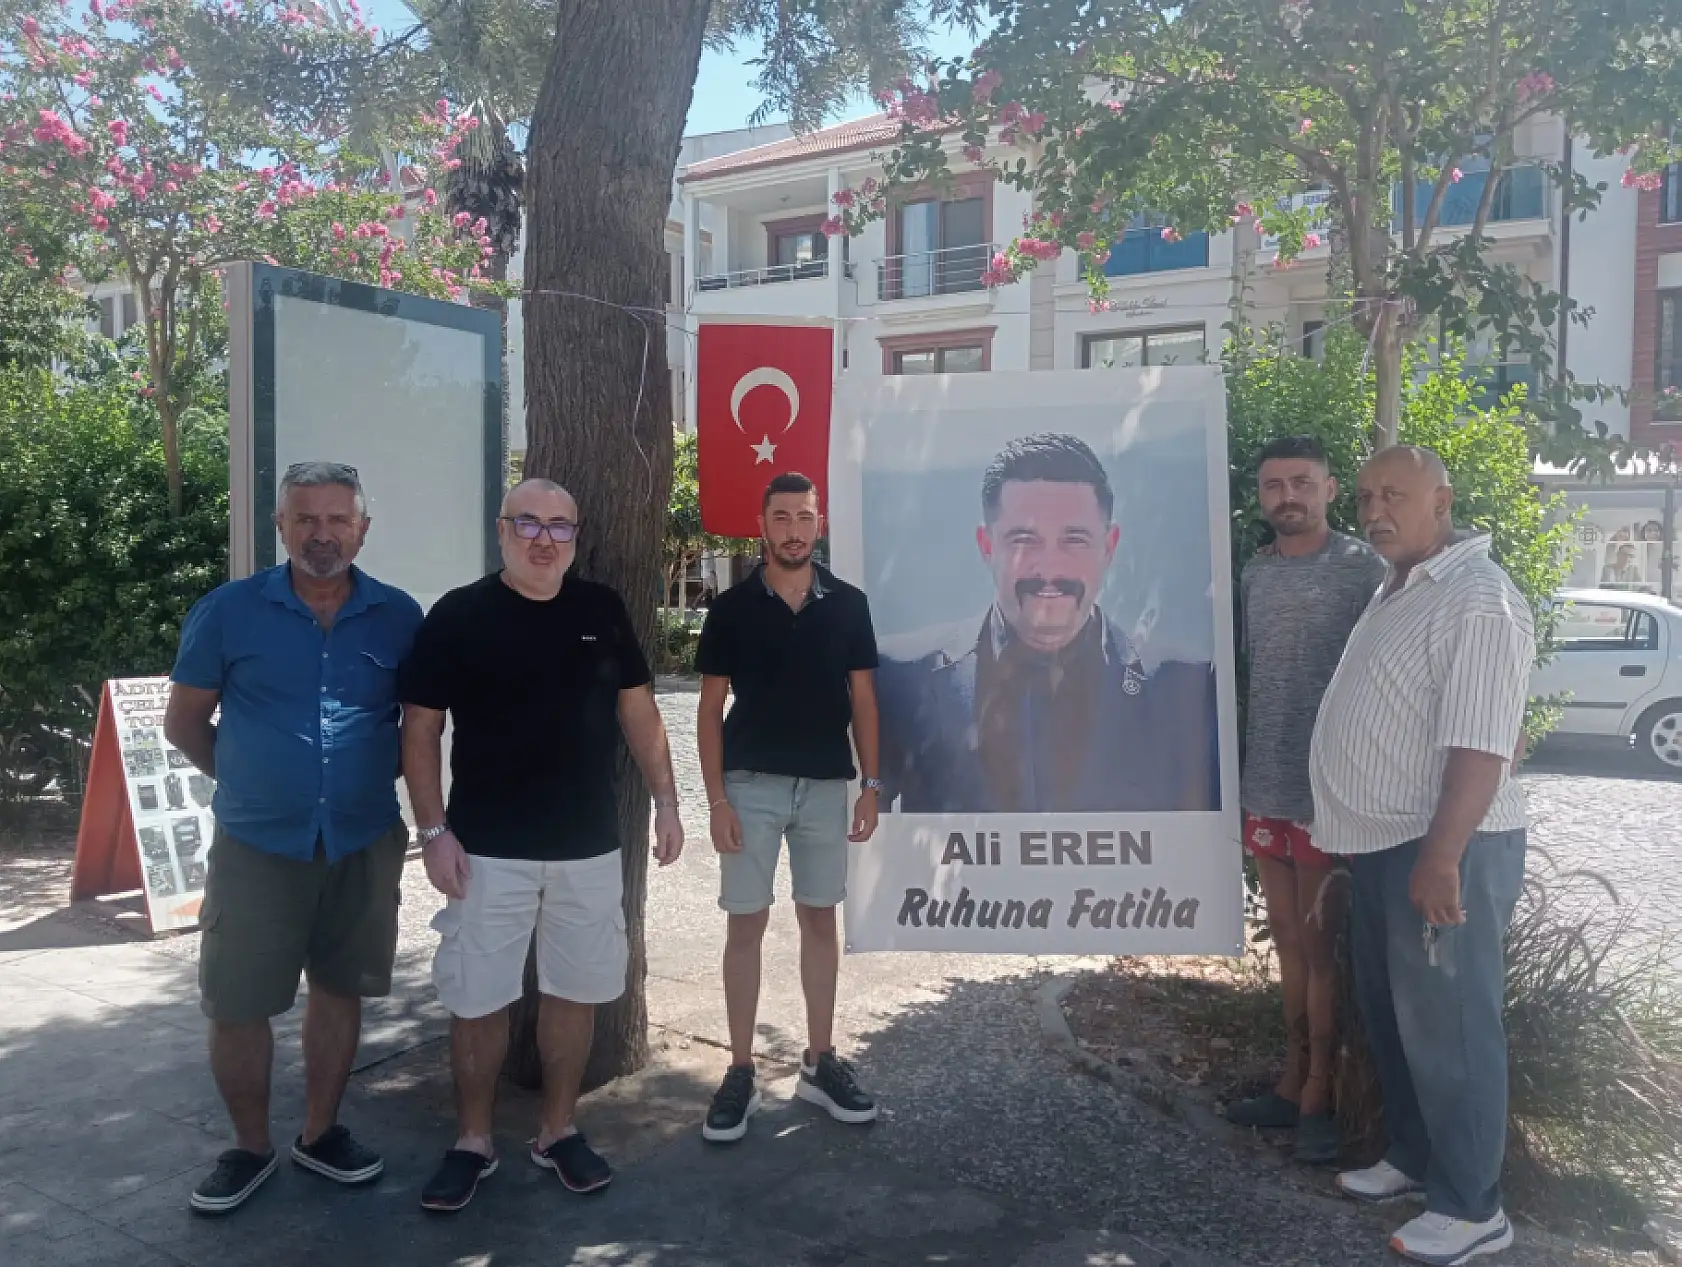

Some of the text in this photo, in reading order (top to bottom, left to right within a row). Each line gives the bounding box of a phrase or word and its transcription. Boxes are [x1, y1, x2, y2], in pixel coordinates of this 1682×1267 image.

[940, 830, 1153, 866] Ali EREN
[897, 887, 1201, 930] Ruhuna Fatiha
